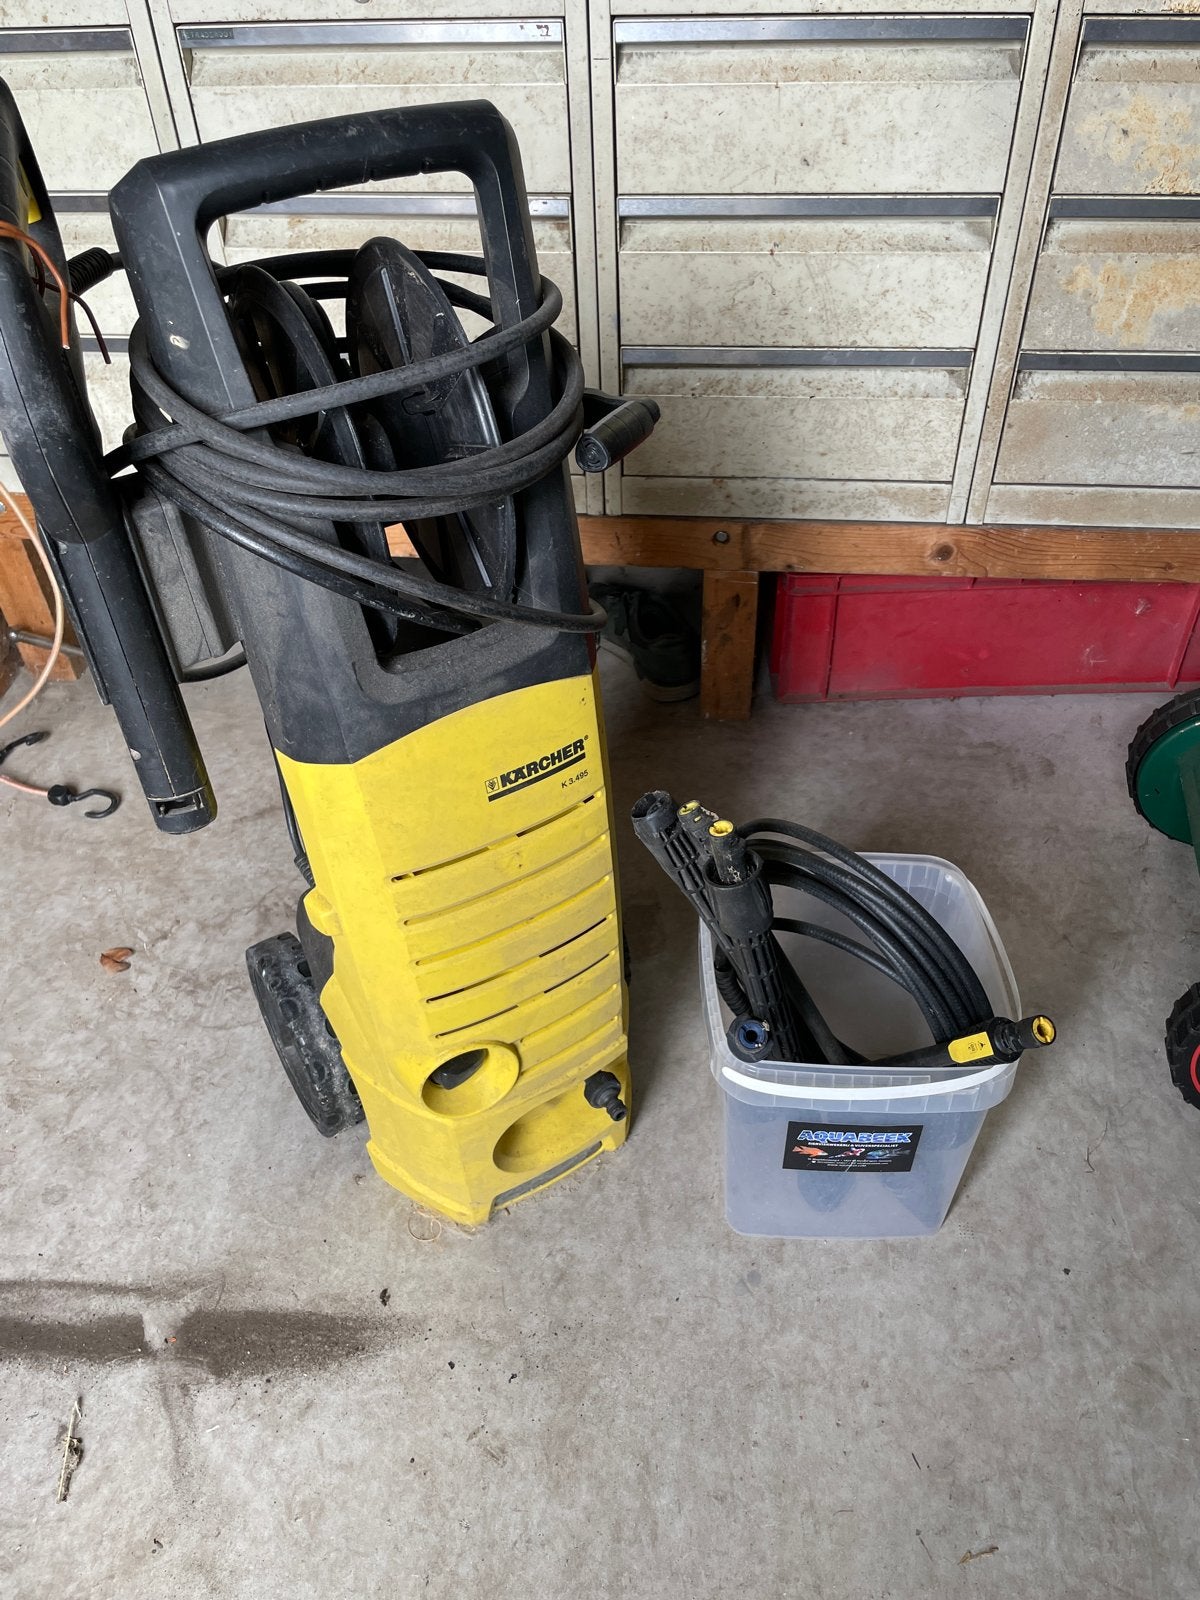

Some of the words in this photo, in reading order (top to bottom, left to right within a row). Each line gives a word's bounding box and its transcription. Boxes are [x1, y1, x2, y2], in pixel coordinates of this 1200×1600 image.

[561, 781, 568, 789] K
[568, 769, 589, 785] 3.495
[797, 1129, 913, 1144] AQUABEEK
